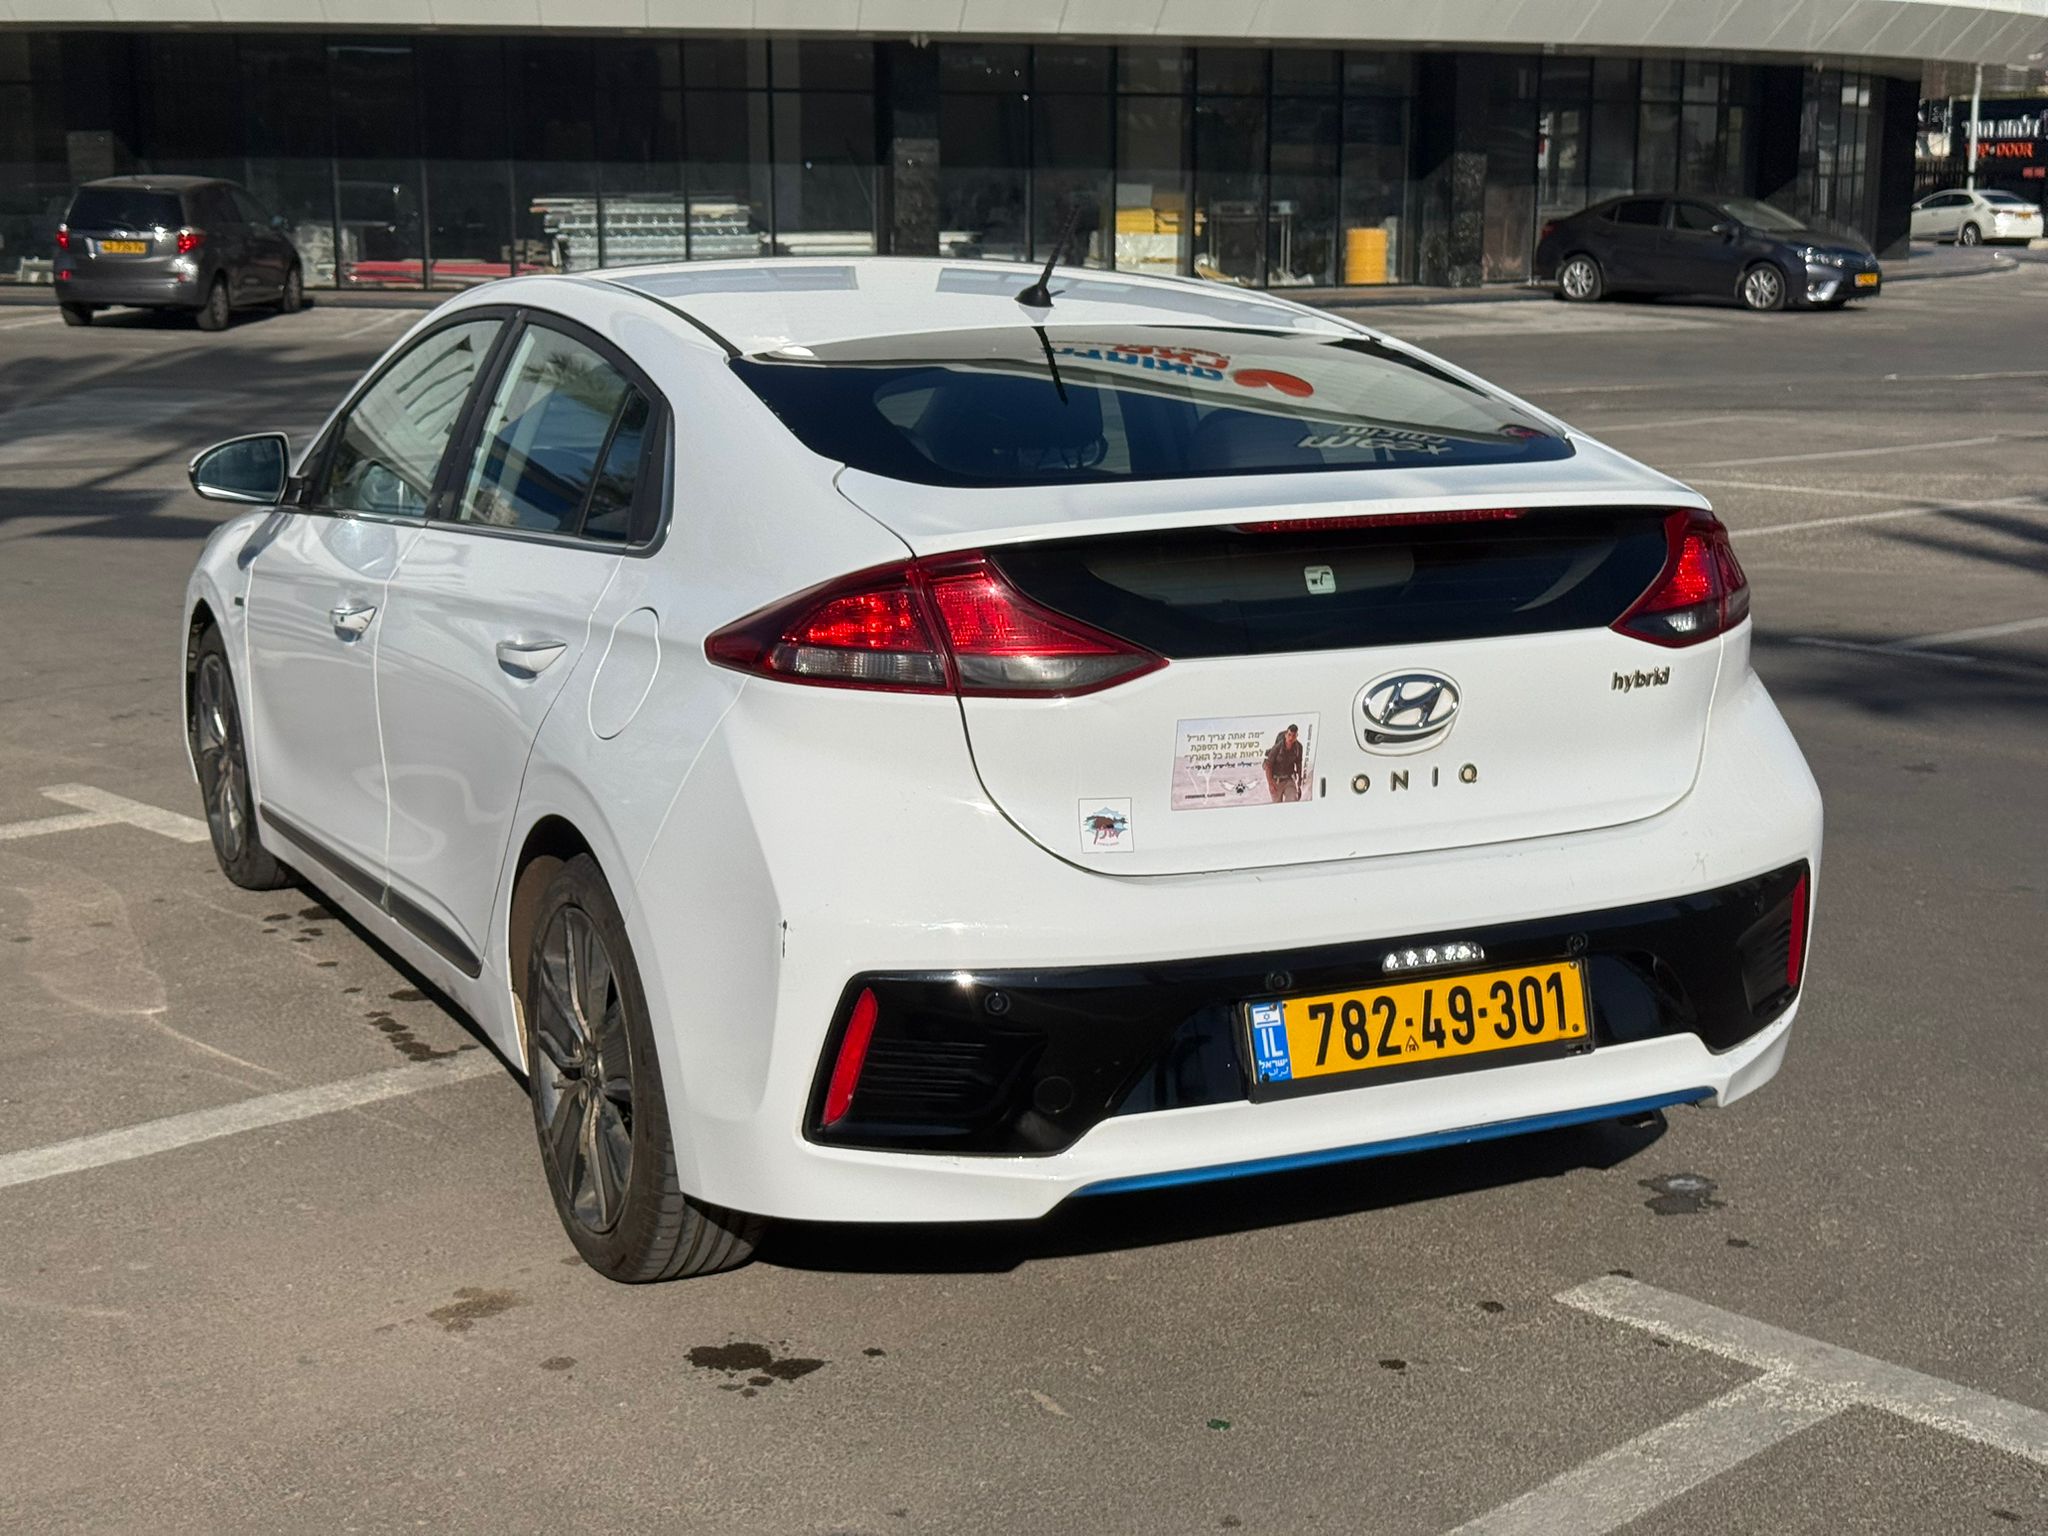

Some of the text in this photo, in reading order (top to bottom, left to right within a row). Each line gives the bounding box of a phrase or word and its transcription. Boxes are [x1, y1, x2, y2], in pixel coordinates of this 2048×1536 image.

[1611, 666, 1671, 694] hybrid
[1208, 734, 1226, 743] צריך
[1228, 732, 1246, 740] אתה
[1190, 741, 1260, 752] כשעוד לא הספקת
[1213, 751, 1223, 760] כל
[1225, 752, 1237, 760] את
[1240, 749, 1264, 759] לראות
[1320, 762, 1478, 799] IONIQ
[1261, 1027, 1284, 1058] IL
[1258, 1058, 1289, 1070] ישראל
